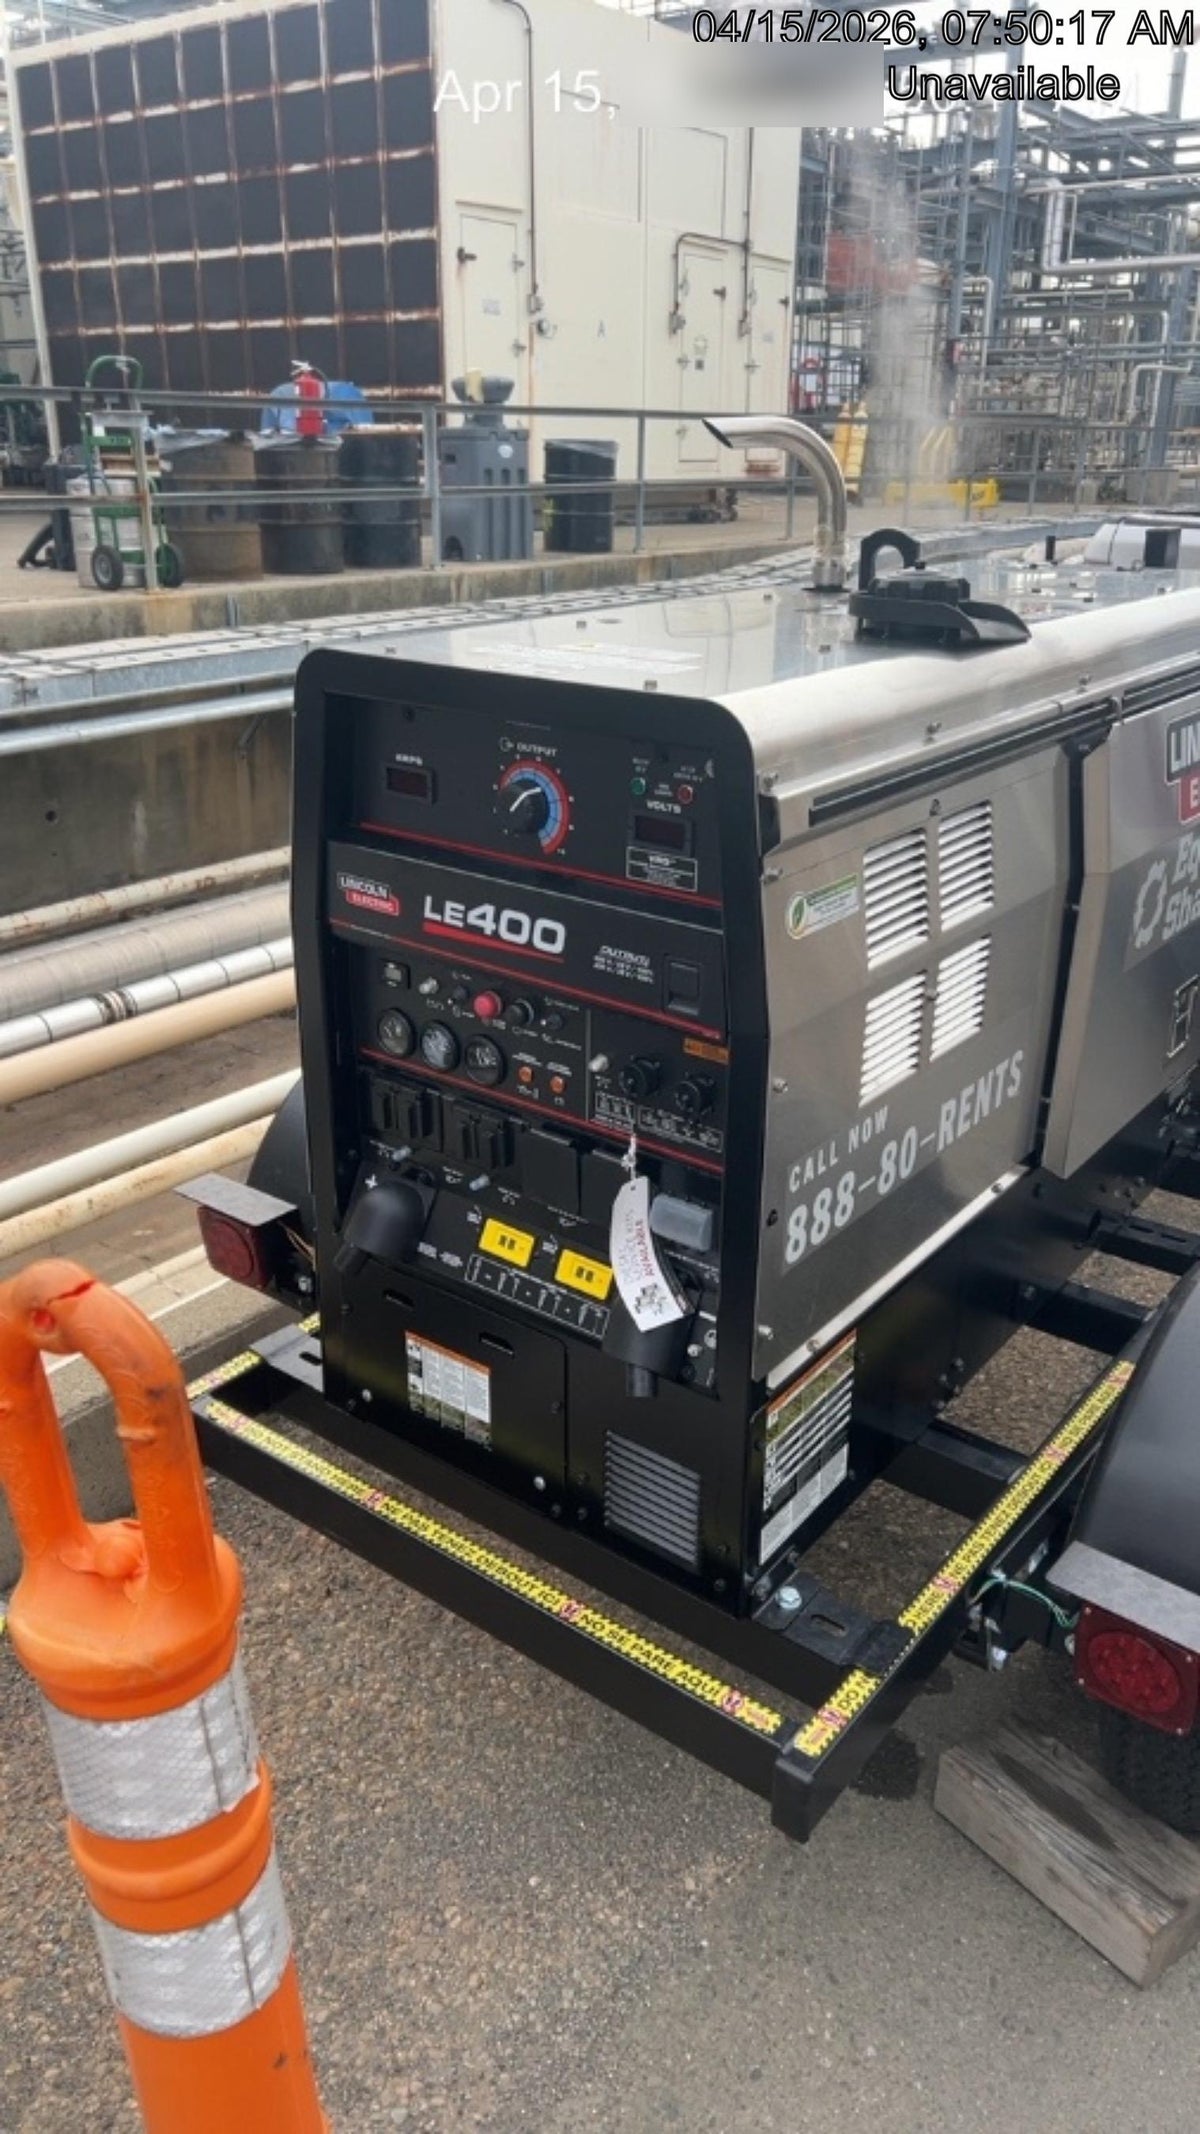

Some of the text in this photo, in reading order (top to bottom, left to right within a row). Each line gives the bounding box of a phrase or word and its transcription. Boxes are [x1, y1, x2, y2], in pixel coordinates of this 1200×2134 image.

[517, 742, 557, 757] OUTPUT
[646, 800, 682, 814] VOLTS
[341, 876, 388, 899] LINCOLN
[352, 890, 394, 912] ELECTRIC
[423, 895, 567, 954] LE400
[784, 1050, 1024, 1264] 888-80-RENTS
[789, 1104, 889, 1193] CALL NOW
[474, 1552, 539, 1595] DEBOUT
[578, 1611, 722, 1699] NO SE PARE AQUI
